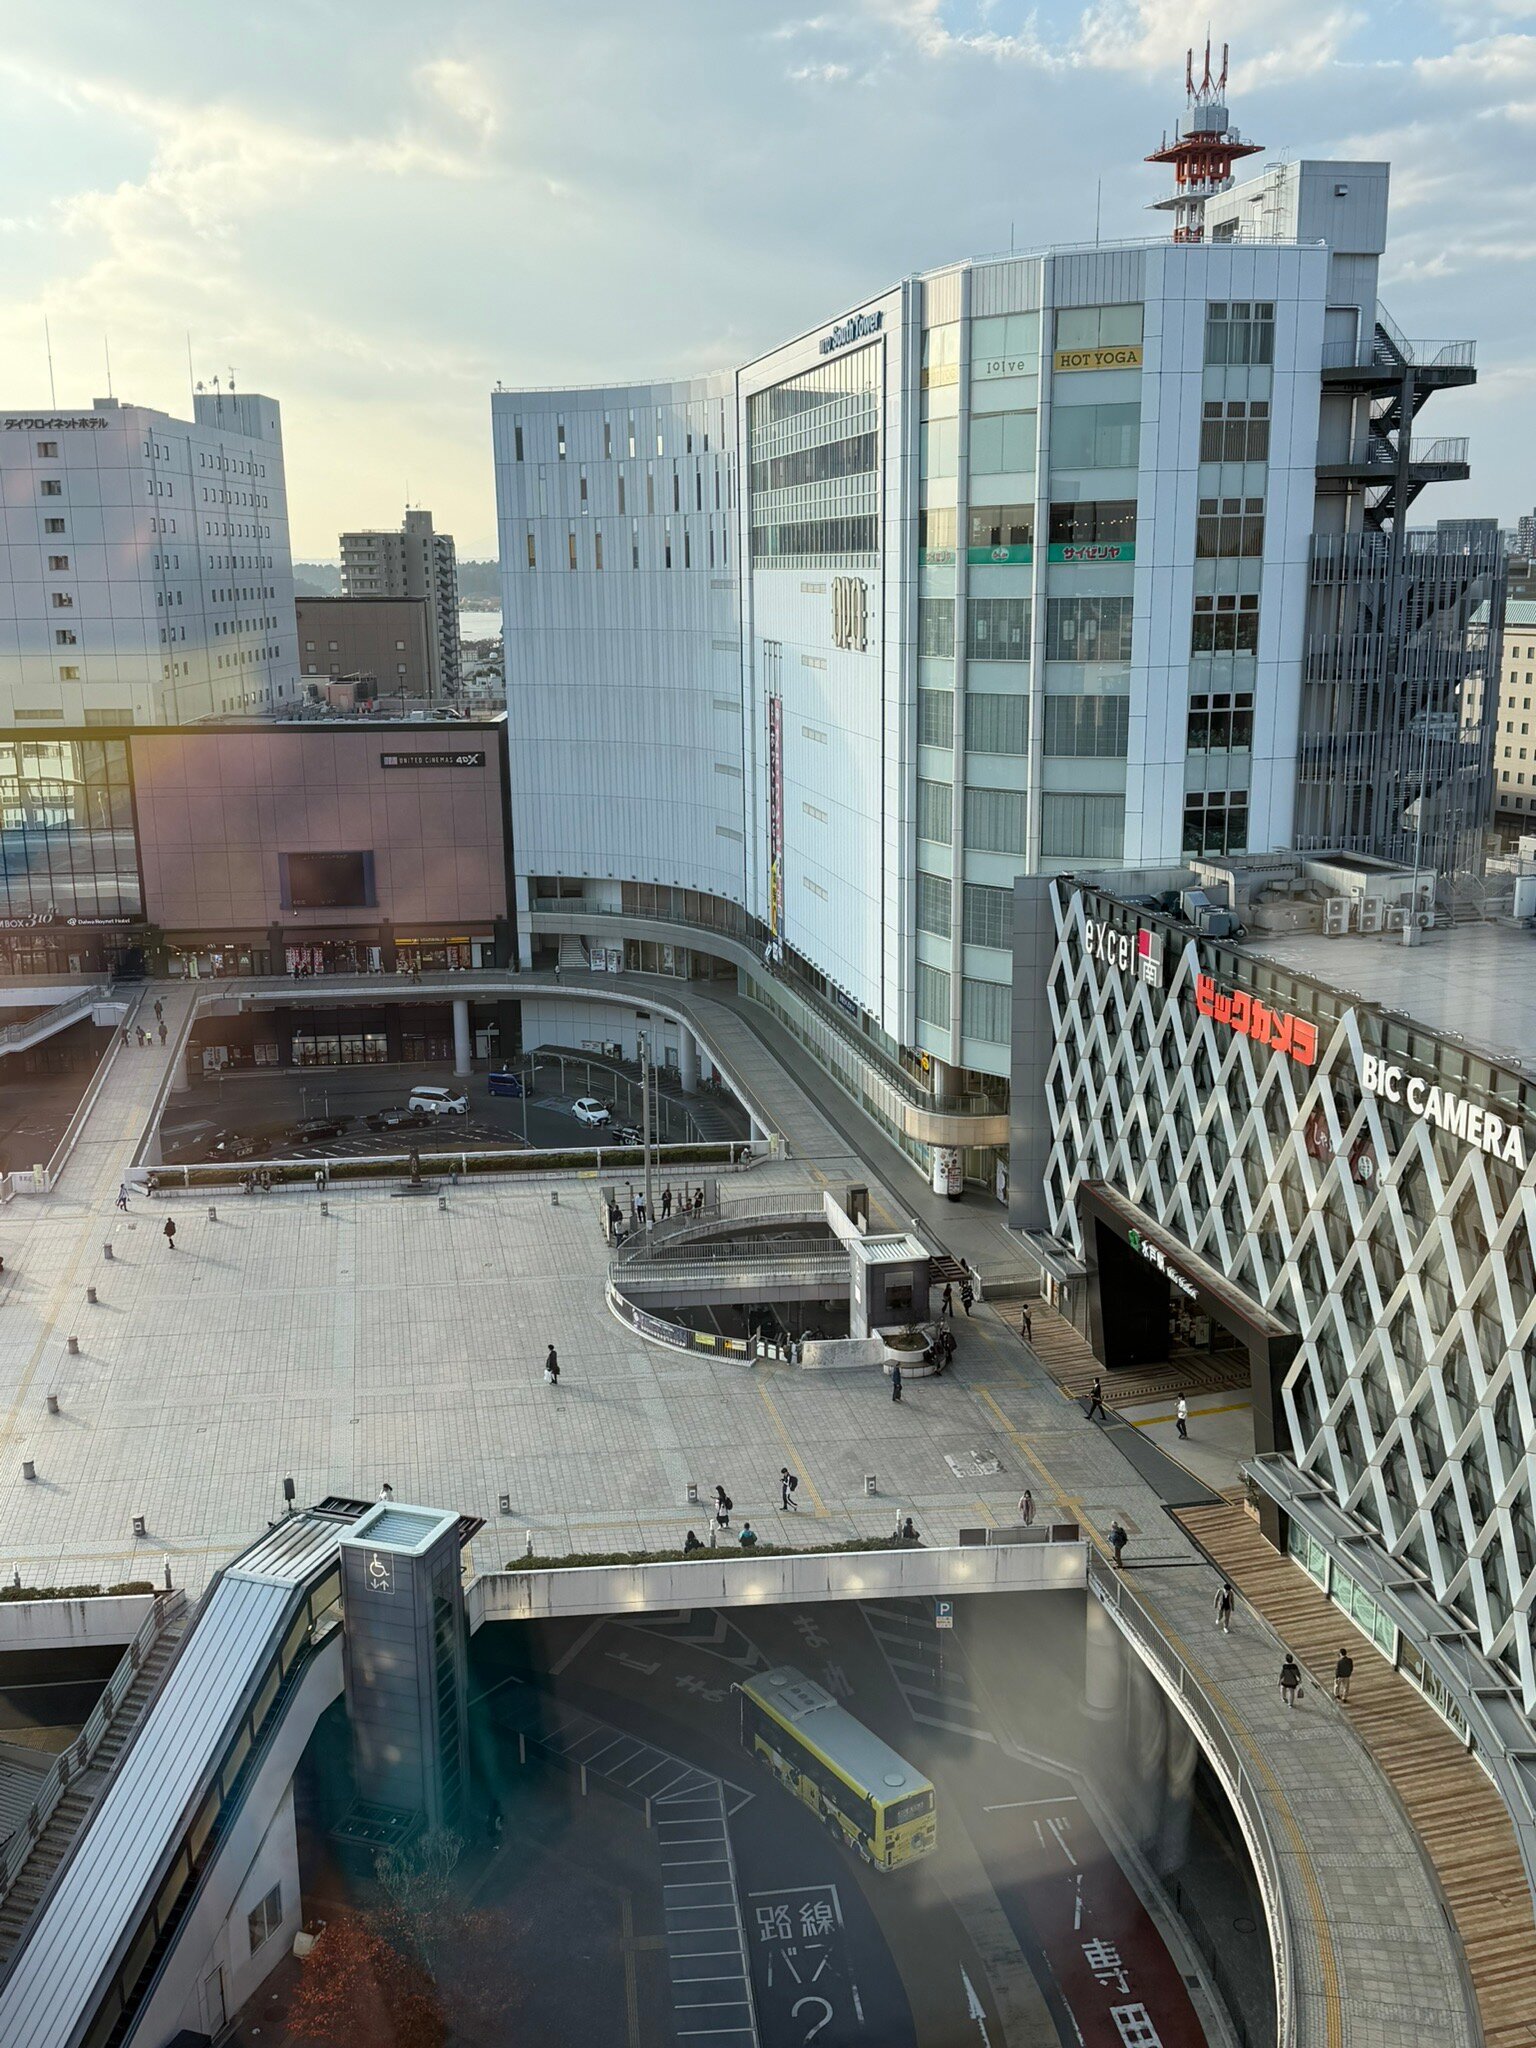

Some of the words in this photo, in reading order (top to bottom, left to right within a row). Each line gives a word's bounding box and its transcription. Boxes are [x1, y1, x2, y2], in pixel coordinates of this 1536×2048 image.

[1060, 354, 1091, 367] HOT
[1094, 351, 1138, 365] YOGA
[4, 417, 108, 430] ダイワロイネットホテル
[1063, 546, 1120, 560] サイゼリヤ
[399, 756, 423, 764] UNITED
[25, 912, 53, 928] 310
[1085, 919, 1135, 976] excel
[1143, 960, 1158, 987] 南
[1196, 972, 1319, 1067] ビックカメラ
[1362, 1052, 1403, 1103] BIC
[1406, 1077, 1527, 1171] CAMERA
[940, 1602, 951, 1616] P
[755, 1901, 836, 1942] 路線
